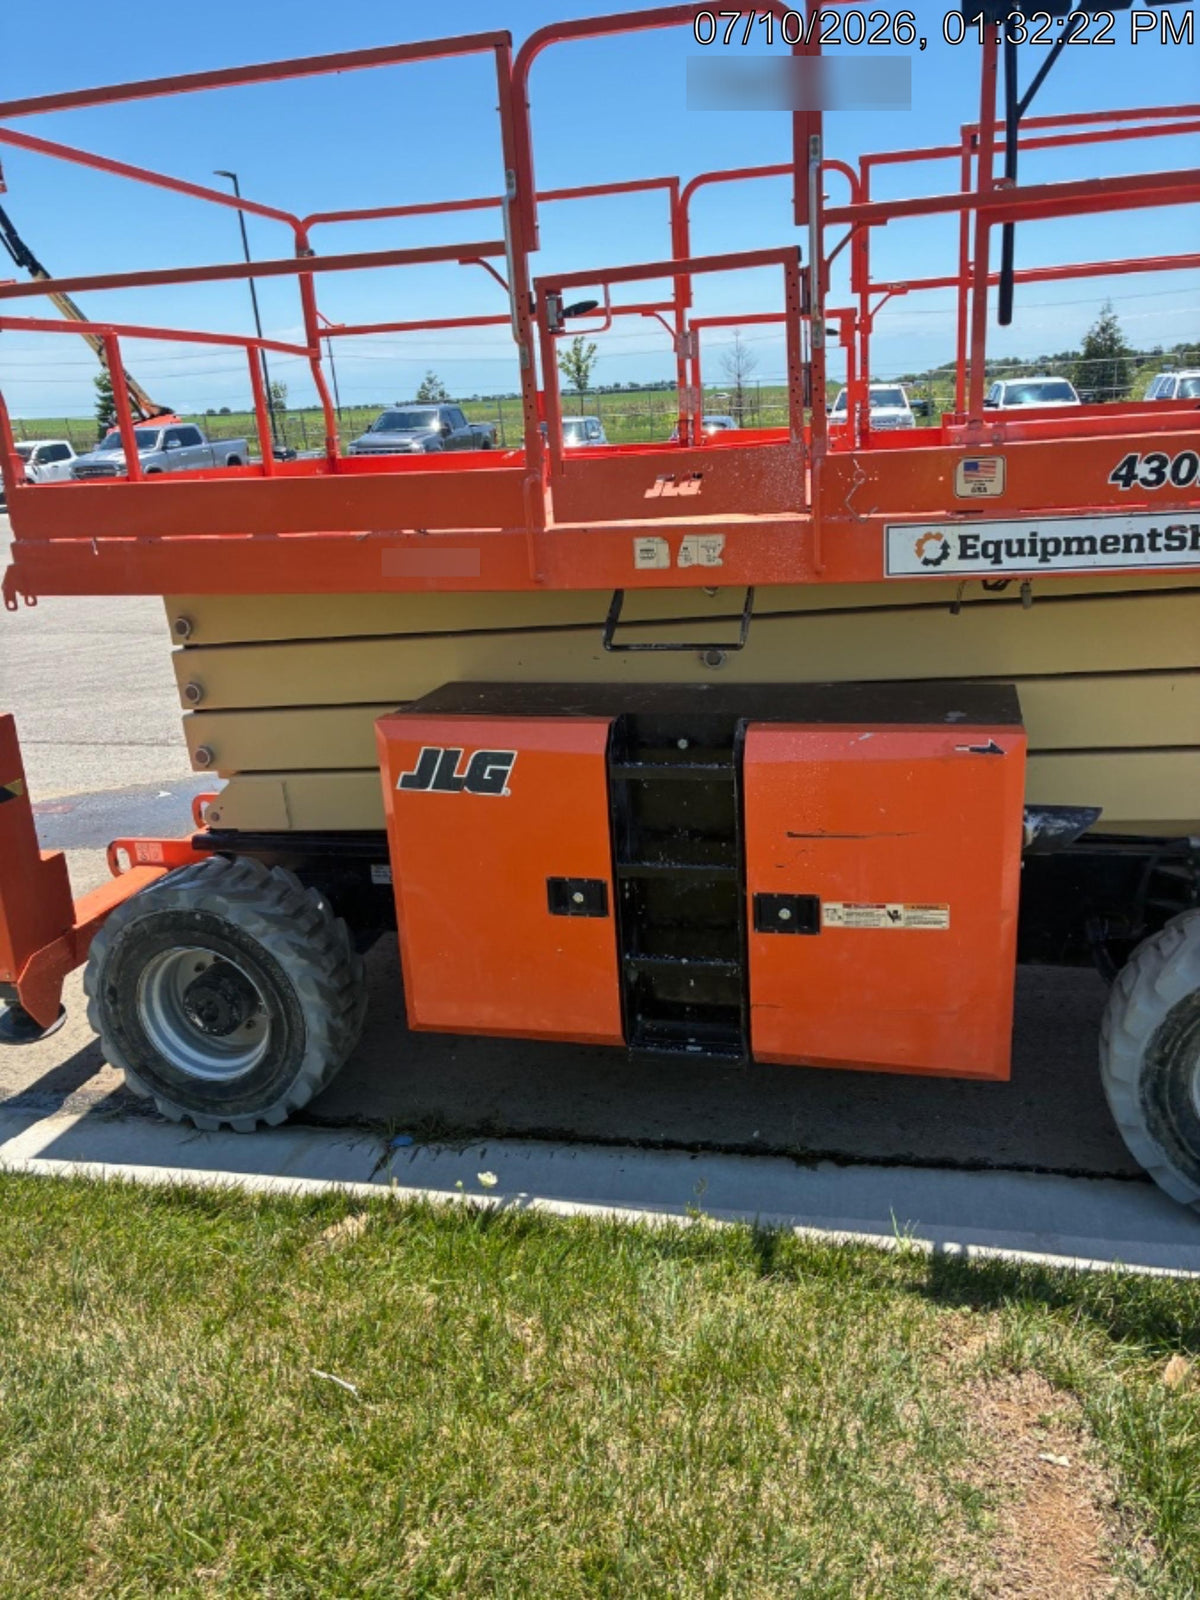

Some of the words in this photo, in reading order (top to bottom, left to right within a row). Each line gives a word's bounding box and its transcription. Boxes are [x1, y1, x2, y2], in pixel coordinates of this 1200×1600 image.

[644, 474, 702, 498] JLG
[1108, 450, 1200, 490] 430
[396, 746, 518, 797] JLG
